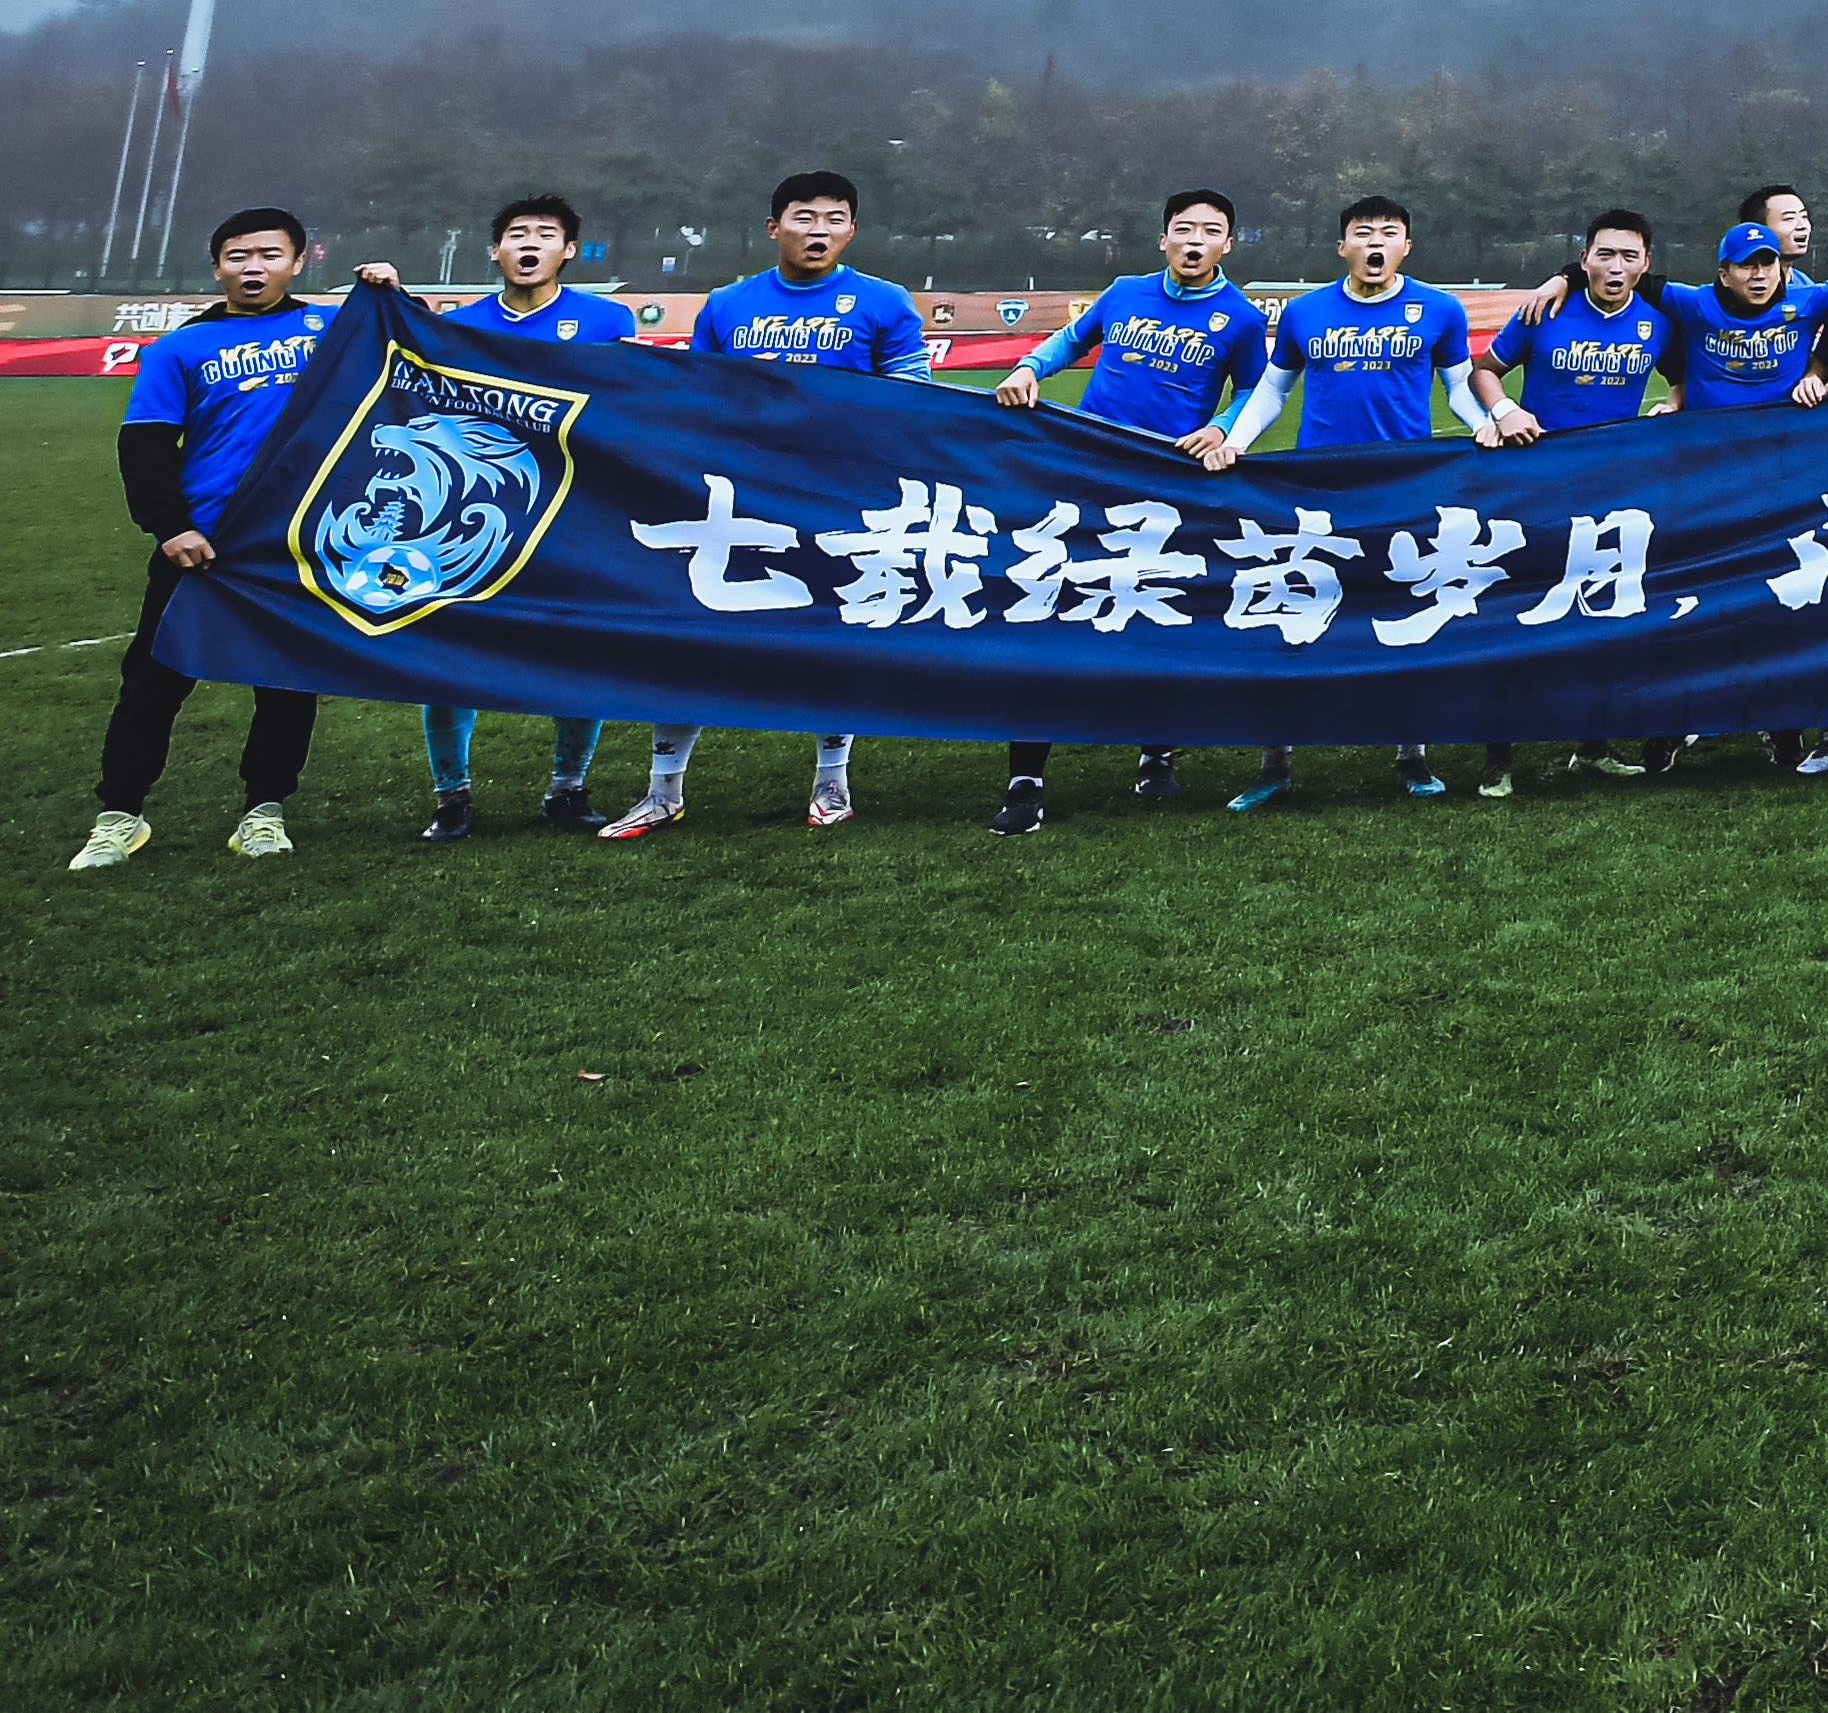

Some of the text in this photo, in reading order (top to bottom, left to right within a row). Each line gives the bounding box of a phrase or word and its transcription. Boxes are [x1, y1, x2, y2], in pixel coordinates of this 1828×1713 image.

[753, 315, 841, 333] WE ARE
[1129, 315, 1208, 344] WE ARE
[1326, 325, 1409, 342] WE ARE
[734, 326, 853, 350] GOING UP
[1108, 321, 1215, 366] GOING UP
[1719, 325, 1786, 343] WE ARE
[219, 342, 261, 364] WE
[1308, 337, 1422, 359] GOING UP
[1571, 340, 1643, 359] WE ARE
[1705, 330, 1798, 358] GOING UP
[201, 345, 297, 385] GOING
[785, 352, 817, 363] 2023
[1148, 357, 1179, 374] 2023
[1361, 360, 1391, 371] 2023
[1552, 348, 1652, 374] GOING UP
[1751, 359, 1778, 370] 2023
[1600, 376, 1626, 385] 2023
